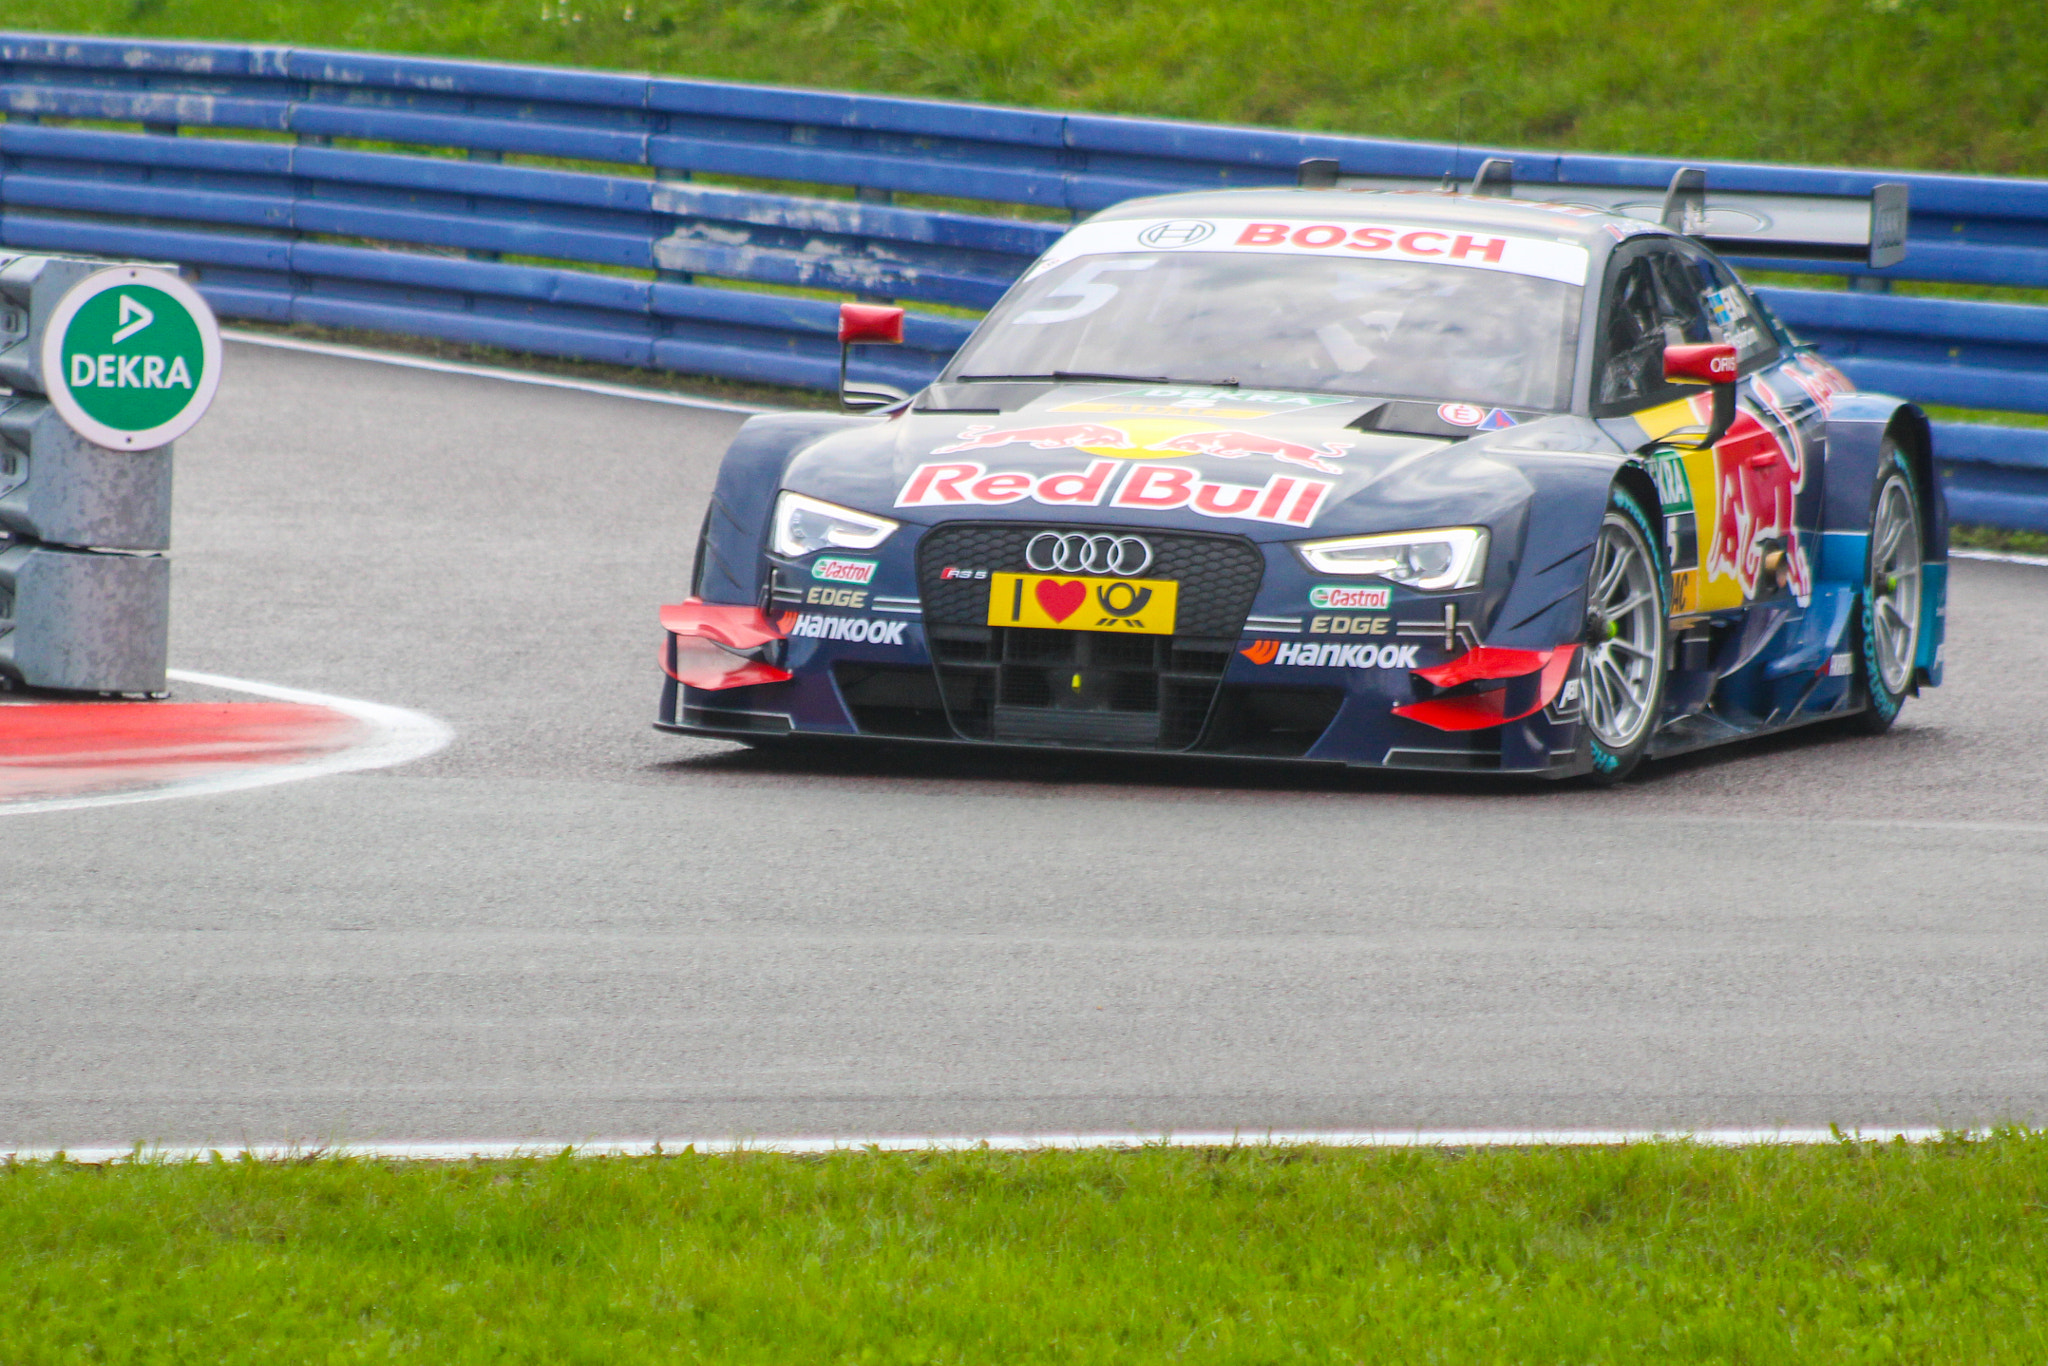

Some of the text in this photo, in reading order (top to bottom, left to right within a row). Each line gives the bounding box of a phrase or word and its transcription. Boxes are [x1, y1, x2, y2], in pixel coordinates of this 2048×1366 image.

[1235, 223, 1506, 264] BOSCH
[1012, 258, 1158, 325] 5
[71, 353, 193, 389] DEKRA
[1144, 389, 1312, 405] DEKRA
[897, 461, 1331, 526] Red Bull
[825, 561, 872, 582] Castrol
[806, 587, 869, 608] EDGE
[1330, 589, 1386, 607] Castrol
[1310, 616, 1391, 635] EDGE
